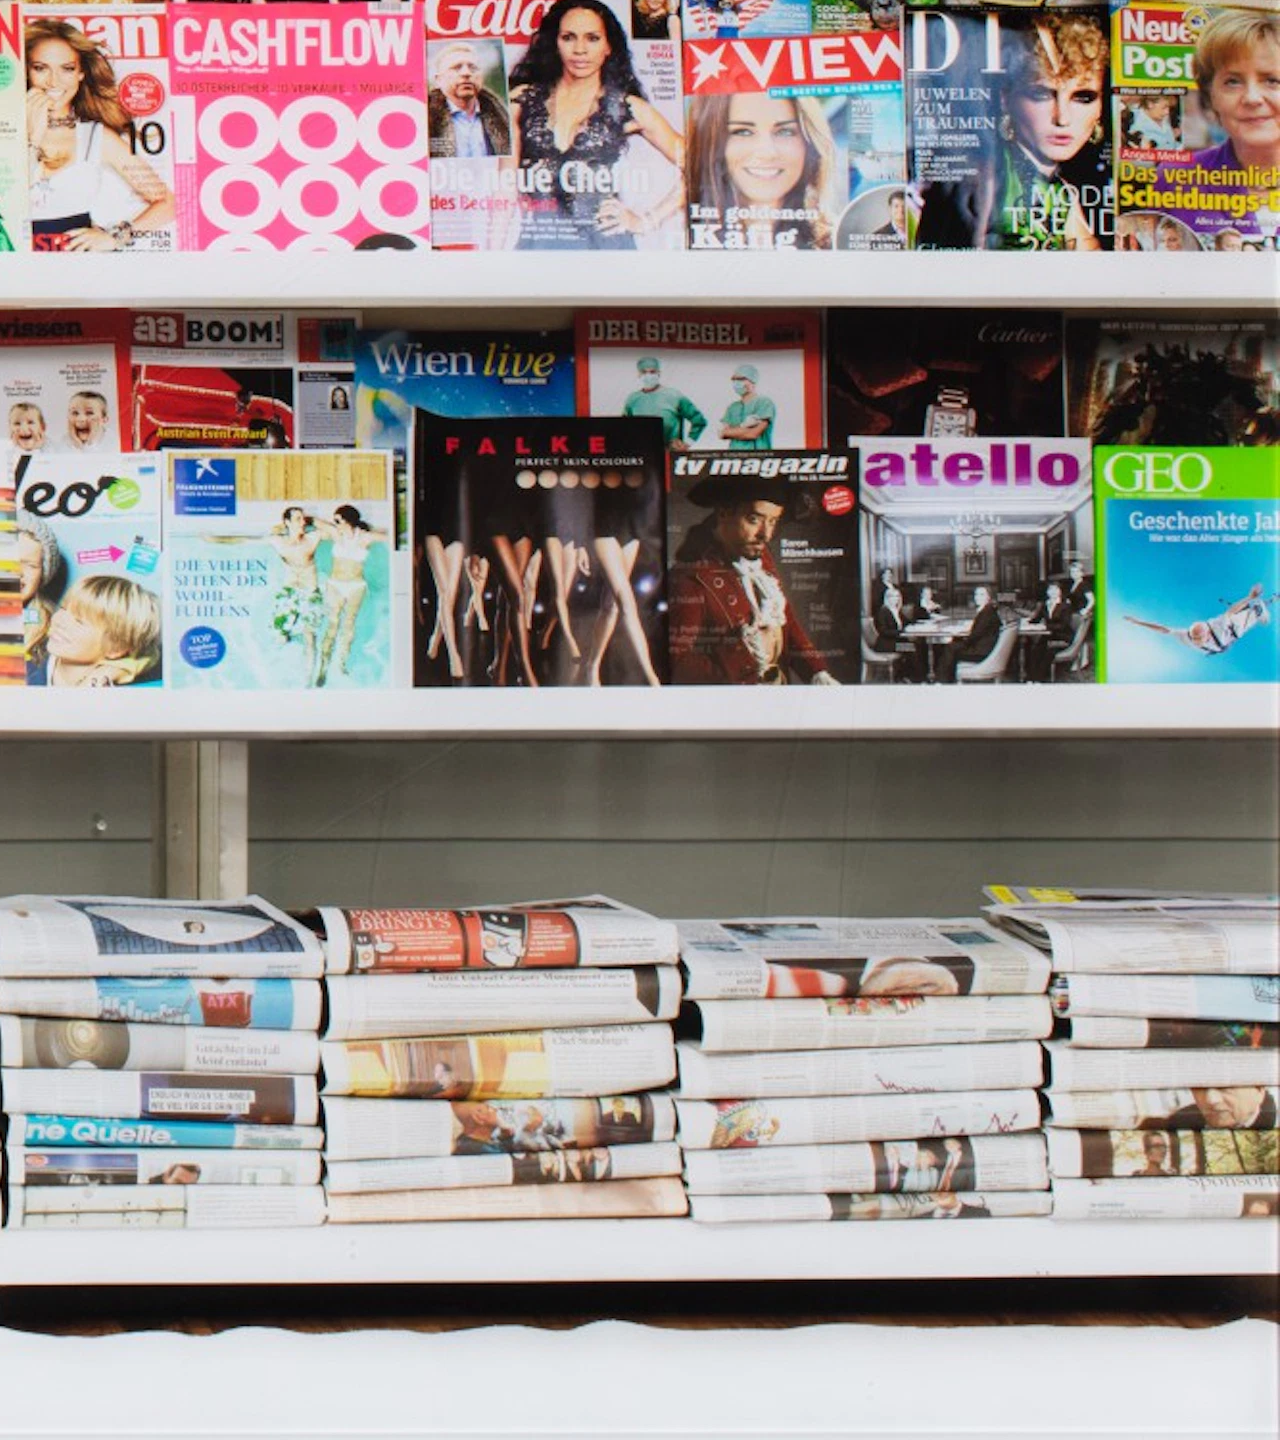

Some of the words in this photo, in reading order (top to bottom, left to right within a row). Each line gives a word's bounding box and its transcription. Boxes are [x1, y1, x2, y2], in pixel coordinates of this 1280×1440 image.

[1125, 47, 1197, 77] Post
[914, 88, 991, 102] JUWELEN
[914, 103, 951, 116] ZUM
[1031, 184, 1114, 207] MODE
[726, 206, 818, 222] goldenen
[691, 222, 799, 250] Käfig
[186, 315, 283, 343] BOOM!
[372, 342, 475, 380] Wien
[485, 343, 556, 377] live
[446, 437, 607, 455] FALKE
[674, 456, 712, 476] tv
[714, 456, 848, 478] magazin
[864, 444, 1081, 487] atello
[1105, 453, 1211, 492] GEO
[1129, 513, 1249, 532] Geschenkte
[72, 1121, 178, 1146] Quelle.
